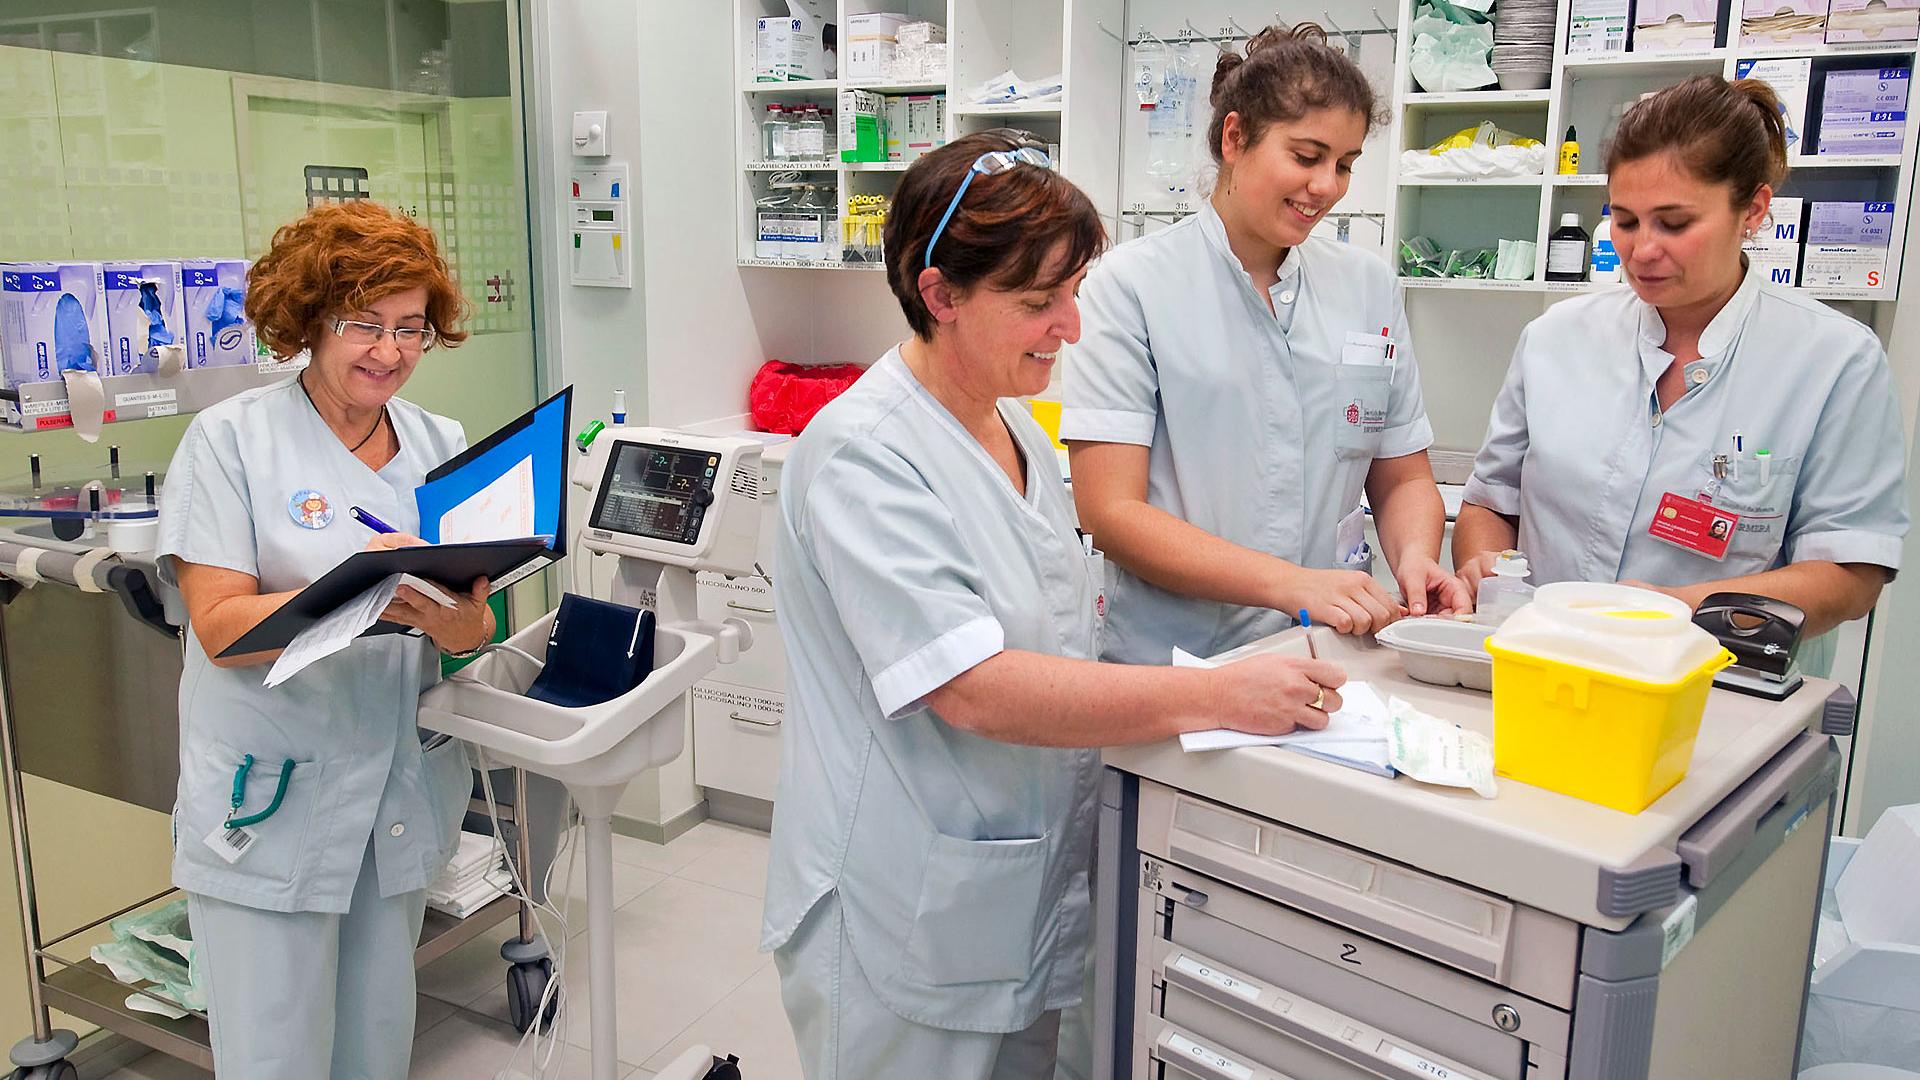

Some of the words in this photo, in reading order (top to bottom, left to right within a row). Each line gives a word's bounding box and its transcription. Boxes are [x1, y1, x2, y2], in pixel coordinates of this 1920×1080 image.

[1179, 29, 1192, 37] 314
[1220, 27, 1233, 35] 316
[1175, 202, 1189, 210] 315
[1775, 224, 1795, 239] M
[32, 275, 44, 290] 6-7
[44, 279, 55, 287] S
[117, 273, 128, 288] 7-8
[1771, 268, 1791, 284] M
[1867, 271, 1879, 287] S
[694, 687, 752, 701] GLUCOSALINO
[694, 693, 752, 708] GLUCOSALINO
[1417, 1061, 1448, 1079] 316
